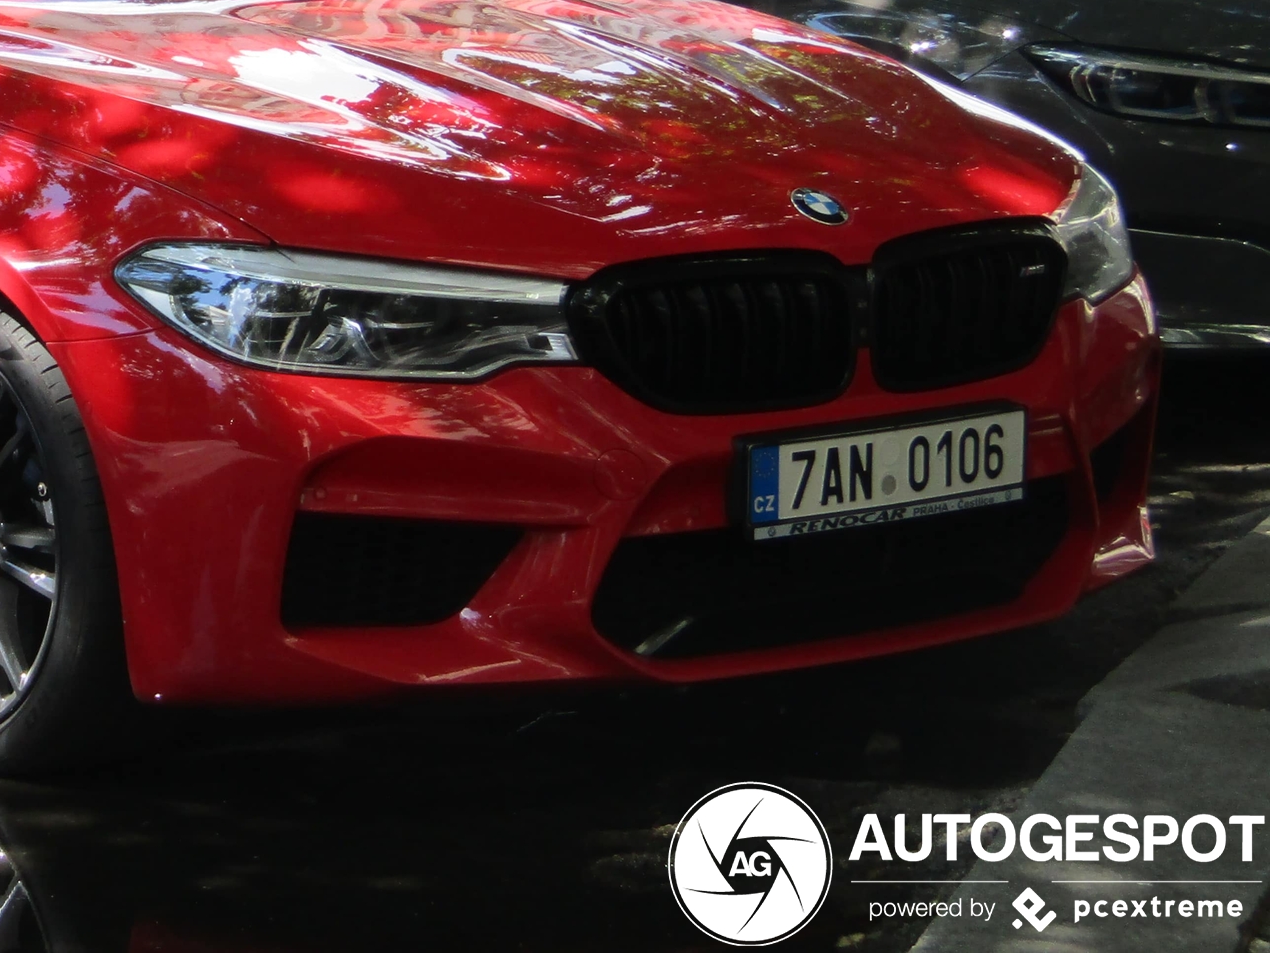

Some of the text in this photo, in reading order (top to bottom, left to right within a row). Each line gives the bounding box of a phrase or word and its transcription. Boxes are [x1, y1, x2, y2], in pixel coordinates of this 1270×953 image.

[791, 423, 1005, 510] 7AN 0106
[753, 494, 776, 514] CZ
[788, 507, 908, 535] RENOCAR
[913, 504, 949, 518] PRAHA
